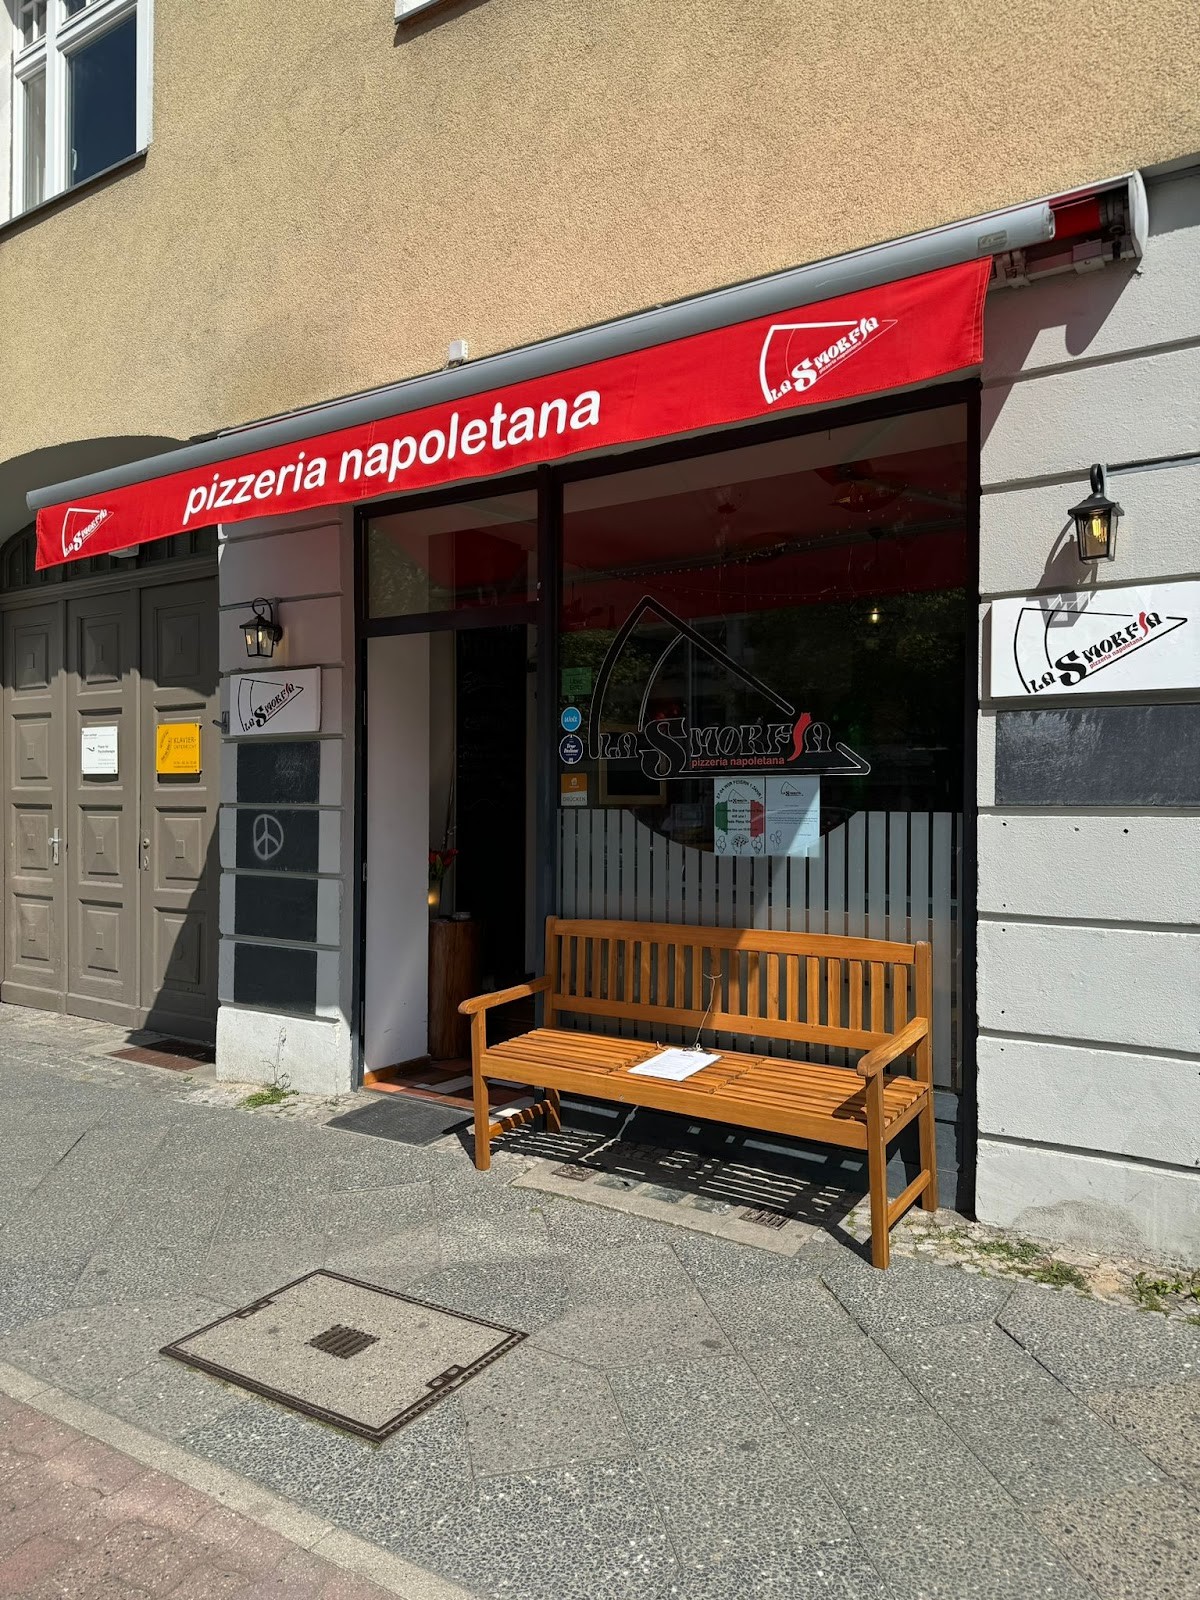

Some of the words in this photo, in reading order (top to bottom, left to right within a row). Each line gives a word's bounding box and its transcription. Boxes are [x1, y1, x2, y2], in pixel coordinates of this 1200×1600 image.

[771, 380, 793, 402] LA
[182, 452, 327, 525] pizzeria
[338, 389, 601, 482] napoletana
[1089, 653, 1112, 670] pizzeria
[1111, 636, 1144, 657] napoletana
[1029, 671, 1056, 693] LA
[599, 732, 639, 759] LA
[691, 758, 728, 769] pizzeria
[729, 756, 785, 767] napoletana
